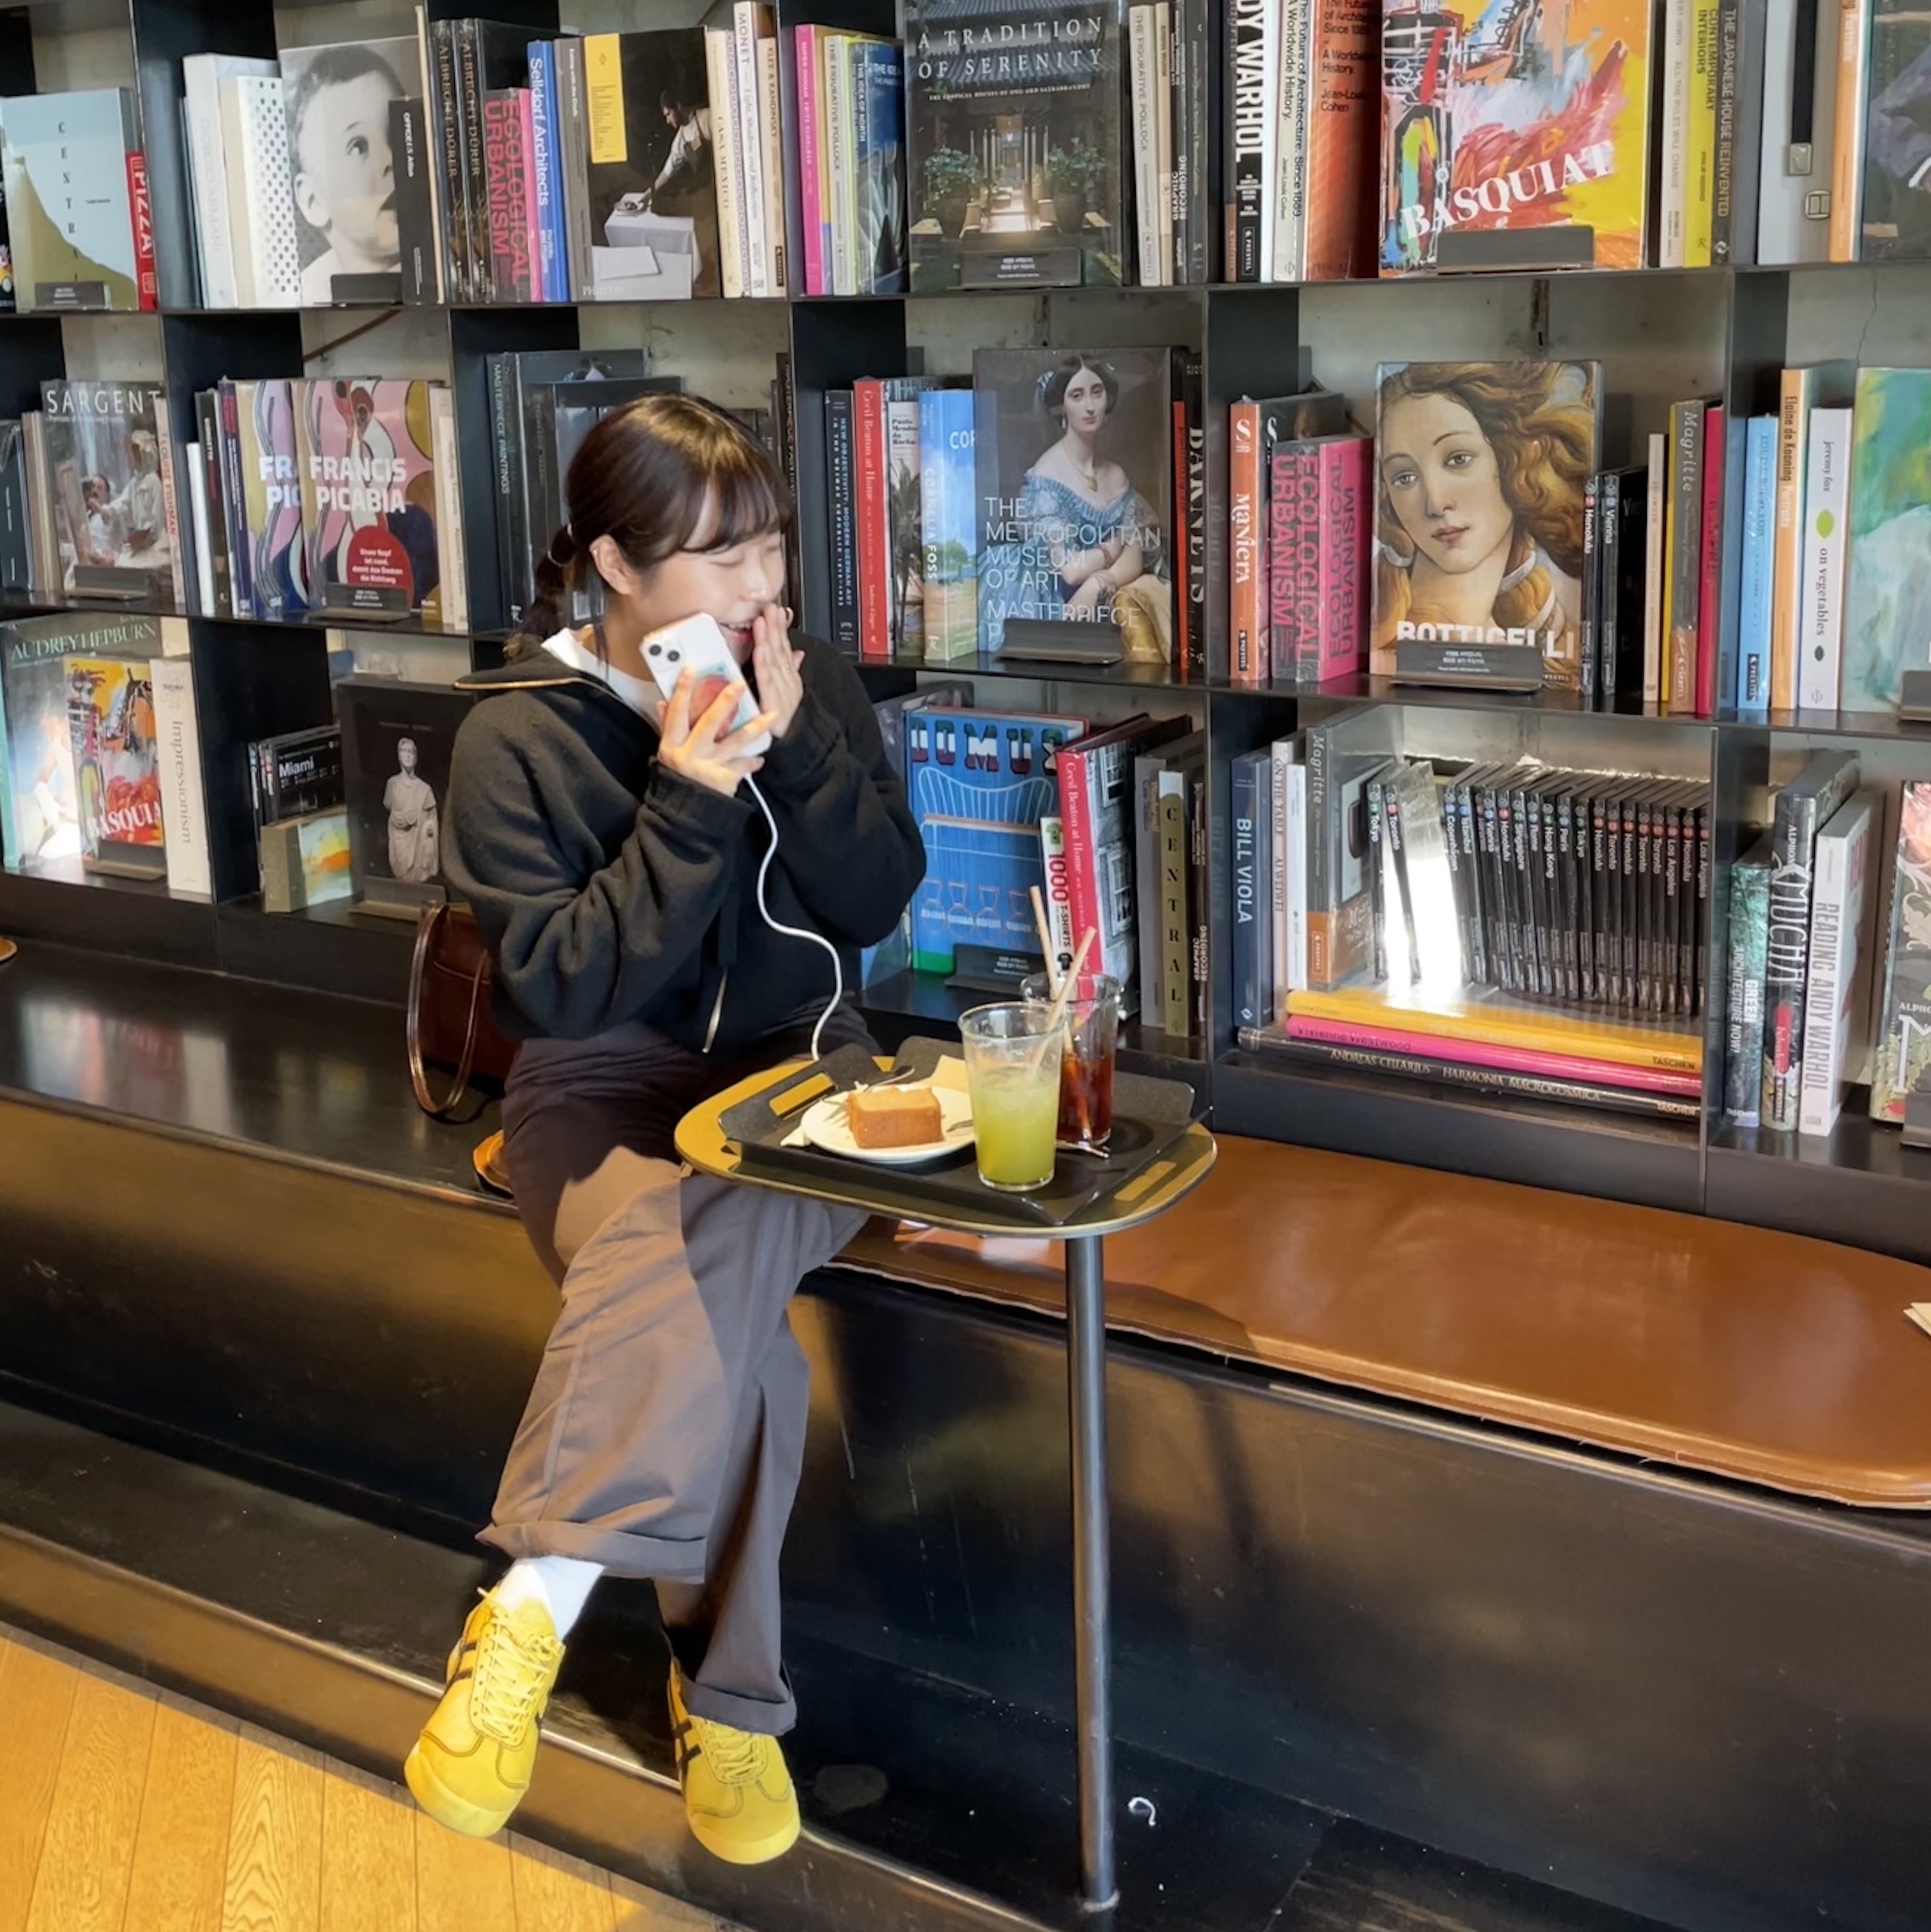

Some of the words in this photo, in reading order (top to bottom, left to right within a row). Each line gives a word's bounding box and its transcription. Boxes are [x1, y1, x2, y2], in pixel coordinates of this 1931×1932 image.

[738, 13, 750, 64] MONET
[918, 33, 931, 49] A
[943, 16, 1102, 47] TRADITION
[1135, 15, 1143, 35] THE
[1297, 22, 1308, 59] Future
[1324, 22, 1349, 34] Since
[1724, 9, 1737, 33] THE
[1286, 13, 1298, 73] Worldwide
[1323, 49, 1330, 60] A
[1697, 9, 1707, 75] INTERIORS
[1706, 8, 1718, 111] CONTEMPORARY
[919, 61, 949, 79] OF
[965, 48, 1102, 75] SERENITY
[1136, 38, 1148, 101] FIGURATIVE
[1296, 63, 1306, 76] of
[1721, 35, 1736, 98] JAPANESE
[530, 57, 546, 120] Selldorf
[830, 66, 840, 122] FIGURATIVE
[1237, 36, 1263, 162] WARHOL
[1283, 76, 1295, 121] History.
[1320, 100, 1350, 112] Cohen
[717, 116, 727, 149] CASA
[1140, 104, 1149, 152] POLLOCK
[1294, 79, 1306, 154] Architecture.
[1720, 99, 1733, 141] HOUSE
[535, 125, 550, 206] Architects
[833, 125, 841, 171] POLLOCK
[485, 101, 510, 255] URBANISM
[502, 100, 530, 286] ECOLOGICAL
[719, 156, 731, 209] MEXICO
[1179, 155, 1187, 220] RECORDING
[1293, 156, 1304, 190] Since
[1400, 140, 1614, 240] BASQUIAT
[1717, 141, 1732, 218] REINVENTED
[134, 171, 154, 254] PIZZA
[1292, 192, 1302, 221] 1889.
[1245, 239, 1253, 271] PRESTEL
[47, 390, 162, 415] SARGENT
[493, 364, 507, 437] MASTERPIECE
[862, 390, 873, 417] Cecil
[1784, 395, 1798, 425] Elaine
[864, 420, 874, 455] Beaton
[1679, 410, 1698, 492] Magritte
[1783, 428, 1797, 440] de
[309, 455, 408, 483] FRANCIS
[499, 439, 511, 495] PAINTINGS
[866, 457, 873, 468] at
[1822, 441, 1835, 475] jeremy
[316, 485, 407, 514] PICABIA
[866, 470, 876, 503] Home
[1823, 476, 1835, 492] fox
[924, 468, 937, 542] CORNELIA
[984, 496, 1030, 519] THE
[986, 521, 1162, 547] METROPOLITAN
[1271, 455, 1296, 627] URBANISM
[1604, 509, 1615, 545] Vienna
[927, 544, 939, 580] FOSS
[986, 544, 1087, 570] MUSEUM
[1295, 455, 1320, 663] ECOLOGICAL
[1329, 464, 1343, 659] ECOLOGICAL
[1342, 487, 1355, 656] URBANISM
[1819, 547, 1829, 566] on
[986, 568, 1019, 589] OF
[1020, 570, 1062, 592] ART
[1815, 568, 1831, 637] vegetables
[12, 635, 79, 662] AUDREY
[80, 622, 156, 650] HEPBURN
[1396, 620, 1575, 661] BOTTICELLI
[169, 720, 192, 844] Impressionism
[279, 756, 315, 779] Miami
[1066, 761, 1078, 789] Cecil
[1309, 734, 1325, 804] Magritte
[1068, 791, 1080, 827] Beaton
[1273, 779, 1284, 801] THE
[1072, 830, 1080, 840] at
[1236, 818, 1252, 861] BILL
[1274, 804, 1284, 837] TABLE
[1370, 814, 1380, 842] Tokyo
[1389, 815, 1401, 851] Toronto
[1486, 820, 1495, 853] Vienna
[1543, 826, 1554, 853] Hong
[1559, 828, 1569, 853] Paris
[1072, 842, 1084, 874] Home
[1500, 821, 1511, 862] Honolulu
[1514, 823, 1525, 871] Singapore
[1575, 829, 1587, 858] Tokyo
[1594, 829, 1604, 872] Honolulu
[1608, 833, 1618, 871] Toronto
[1623, 832, 1633, 876] Honolulu
[1638, 835, 1649, 873] Toronto
[1652, 837, 1663, 875] Toronto
[1667, 838, 1677, 856] Los
[1682, 839, 1693, 882] Honolulu
[1700, 840, 1709, 859] Los
[1545, 853, 1556, 879] Kong
[1665, 857, 1677, 897] Angeles
[1698, 859, 1709, 899] Angeles
[1048, 851, 1069, 902] 1000
[1060, 904, 1072, 947] T-SHIRTS
[1166, 807, 1182, 1003] CENTRAL
[1237, 865, 1253, 924] VIOLA
[1767, 851, 1813, 984] MUCHA
[1812, 902, 1840, 971] READING
[1192, 937, 1201, 981] GRAPHIC
[1200, 925, 1209, 982] RECORDING
[1730, 945, 1744, 1023] ARCHITECTURE
[1743, 979, 1759, 1023] GREEN
[1808, 977, 1836, 1023] ANDY
[1298, 1023, 1347, 1044] Vivienne
[1348, 1030, 1412, 1052] Westwood
[1729, 1024, 1743, 1054] NOW!
[1804, 1023, 1834, 1091] WARHOL
[1329, 1047, 1377, 1066] ANDREAS
[1378, 1056, 1432, 1076] CELLARIUS
[1442, 1065, 1505, 1085] HARMONIA
[1507, 1075, 1601, 1102] MACROCOSMICA
[1652, 1055, 1696, 1070] TASCHEN
